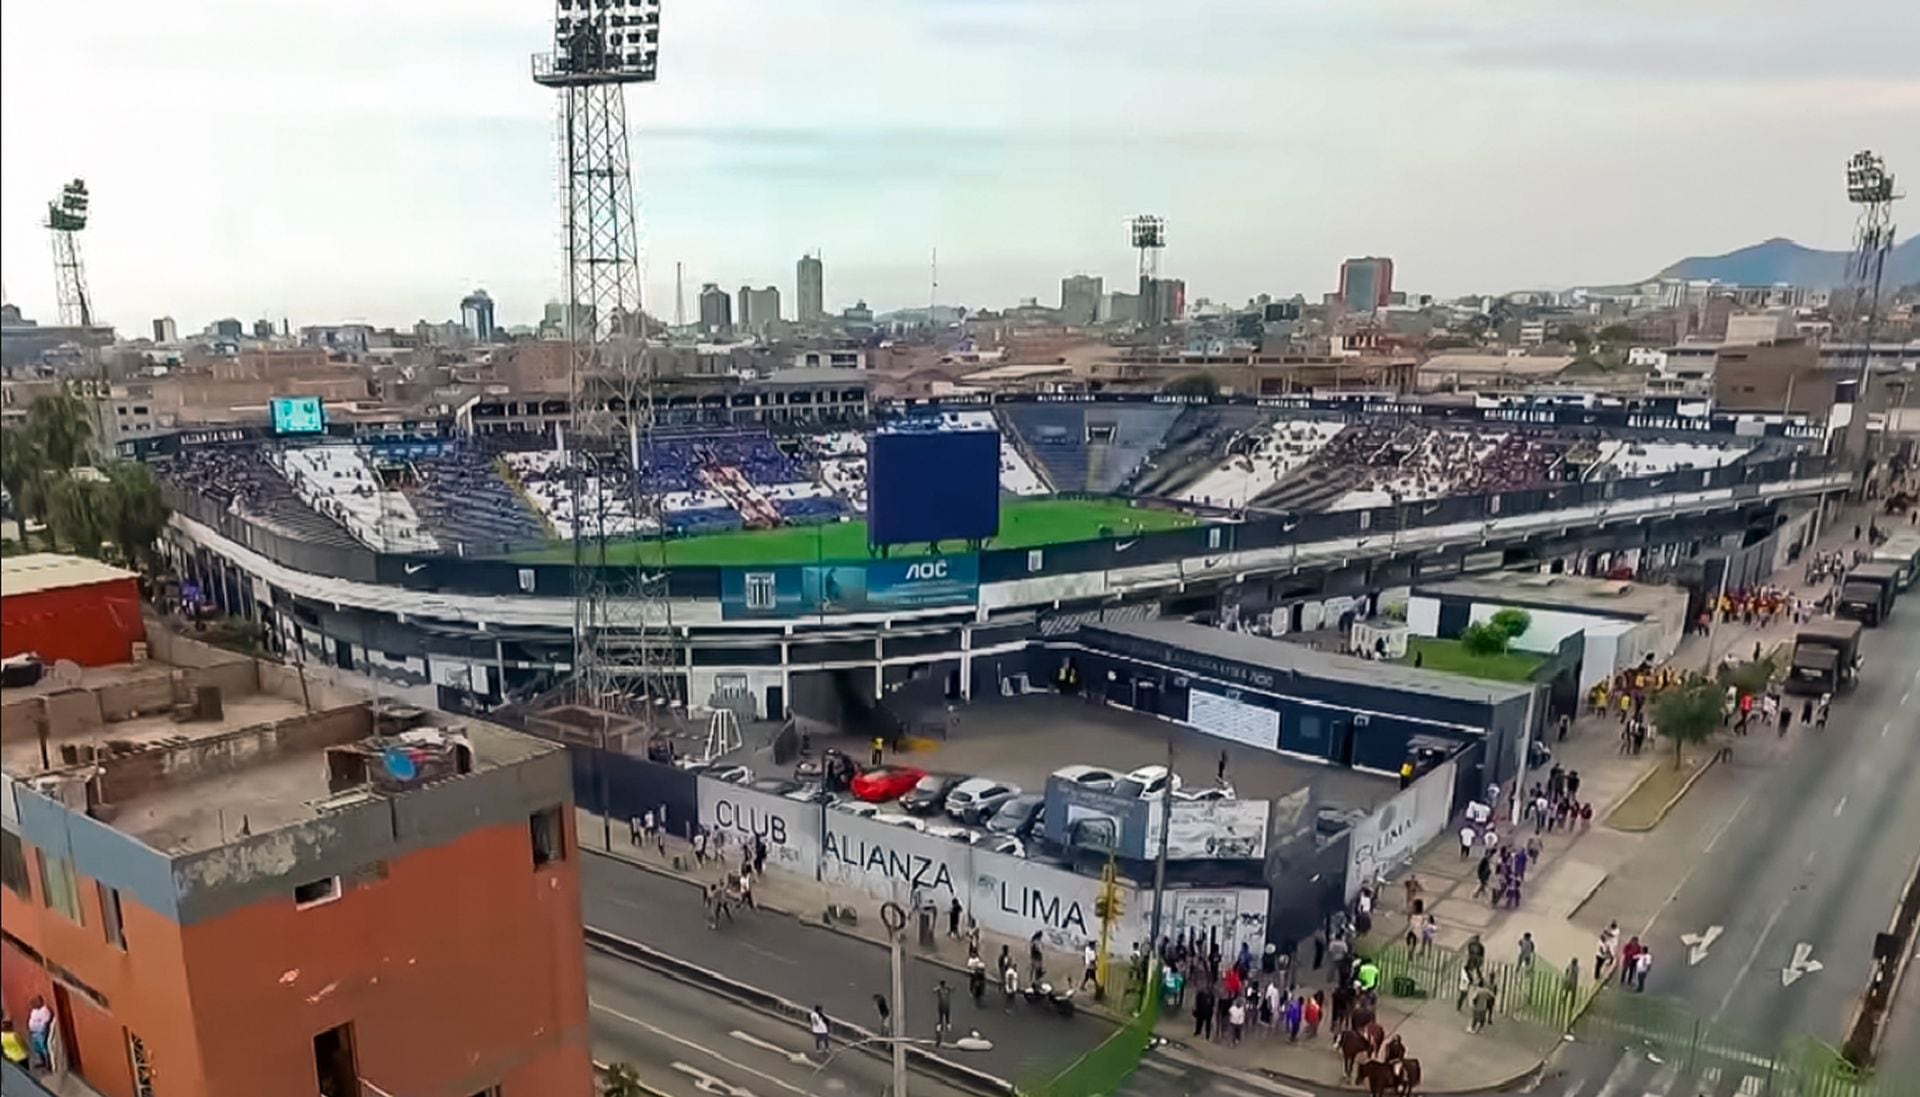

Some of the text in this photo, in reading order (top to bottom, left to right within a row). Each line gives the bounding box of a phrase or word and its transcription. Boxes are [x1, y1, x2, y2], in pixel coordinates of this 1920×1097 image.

[1627, 415, 1679, 428] ALIANZA
[904, 559, 948, 580] AOC
[715, 799, 1088, 936] CLUB ALIANZA LIMA
